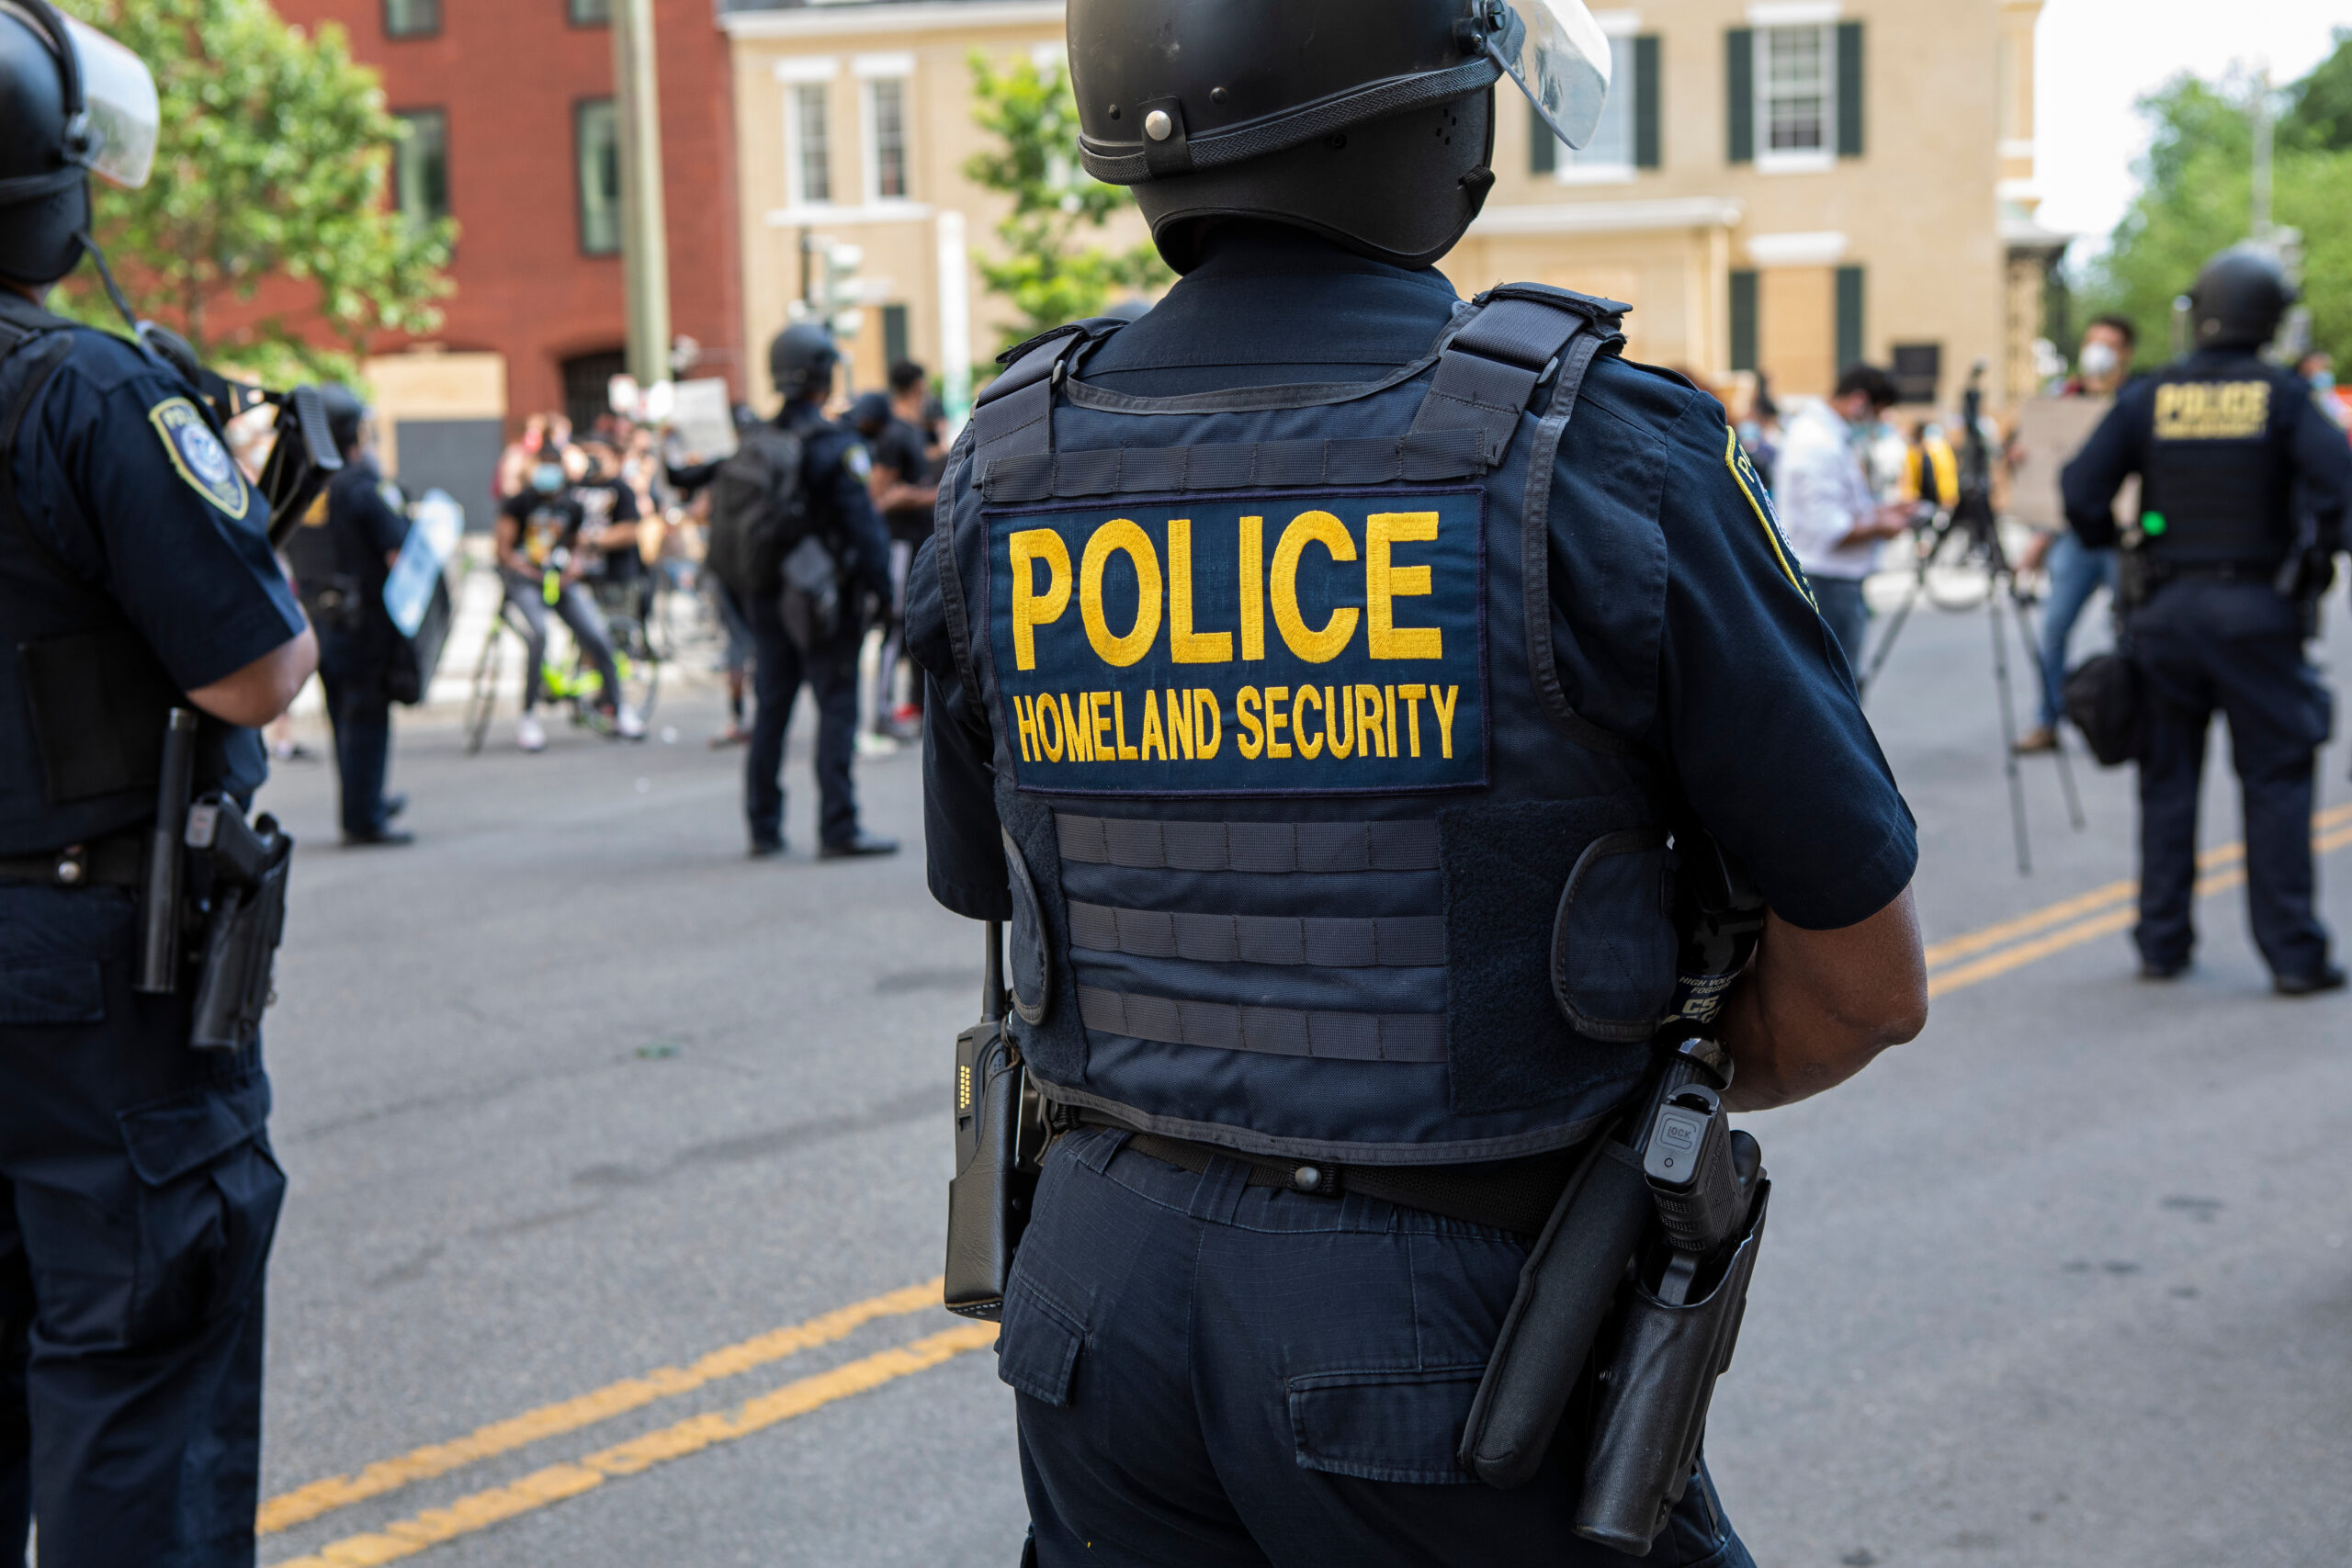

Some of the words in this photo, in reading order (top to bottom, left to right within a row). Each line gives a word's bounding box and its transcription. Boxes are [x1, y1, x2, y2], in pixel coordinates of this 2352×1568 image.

[1010, 511, 1442, 671] POLICE
[1013, 688, 1222, 763] HOMELAND
[1237, 683, 1459, 761] SECURITY
[1678, 976, 1707, 987] HIGH
[1681, 995, 1721, 1014] CS
